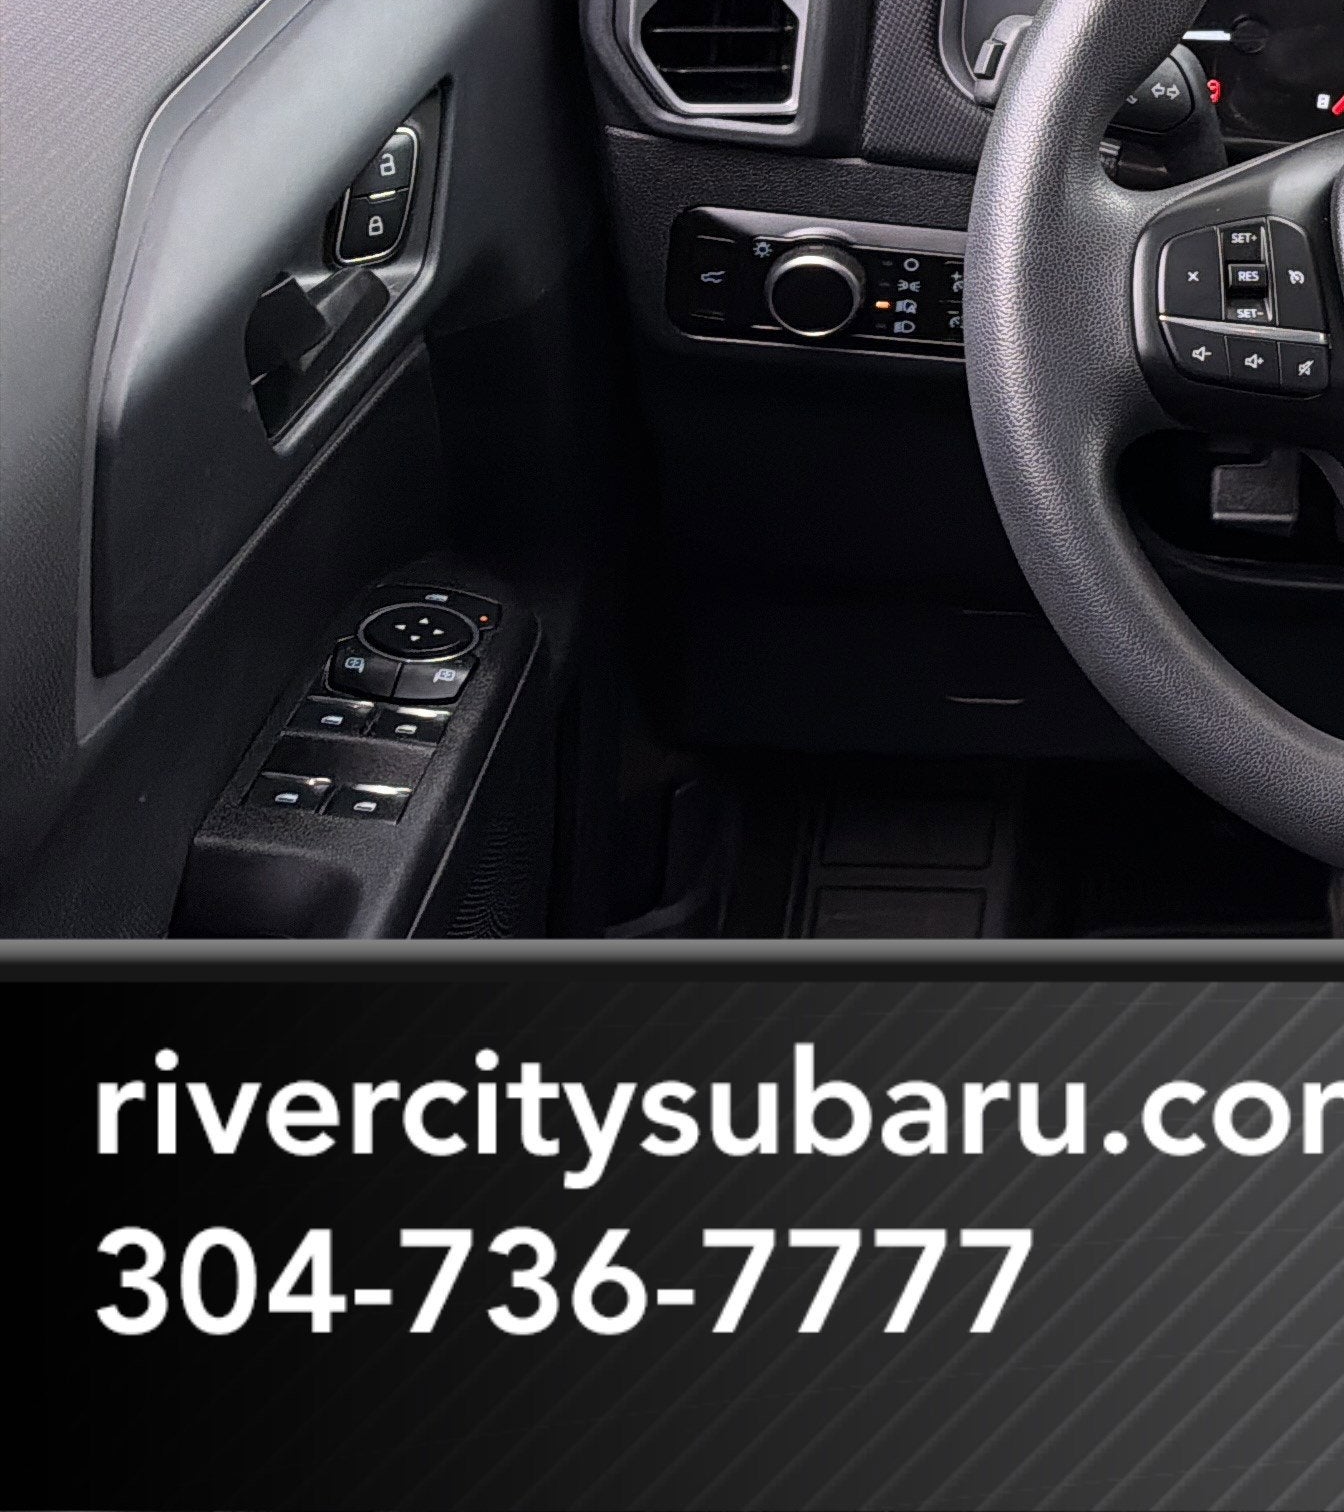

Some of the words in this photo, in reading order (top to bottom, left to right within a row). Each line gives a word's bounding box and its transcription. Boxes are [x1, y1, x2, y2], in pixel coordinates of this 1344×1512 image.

[1317, 94, 1330, 109] 8
[1231, 233, 1258, 244] SET+
[1238, 270, 1260, 282] RES
[1236, 308, 1264, 319] SET-
